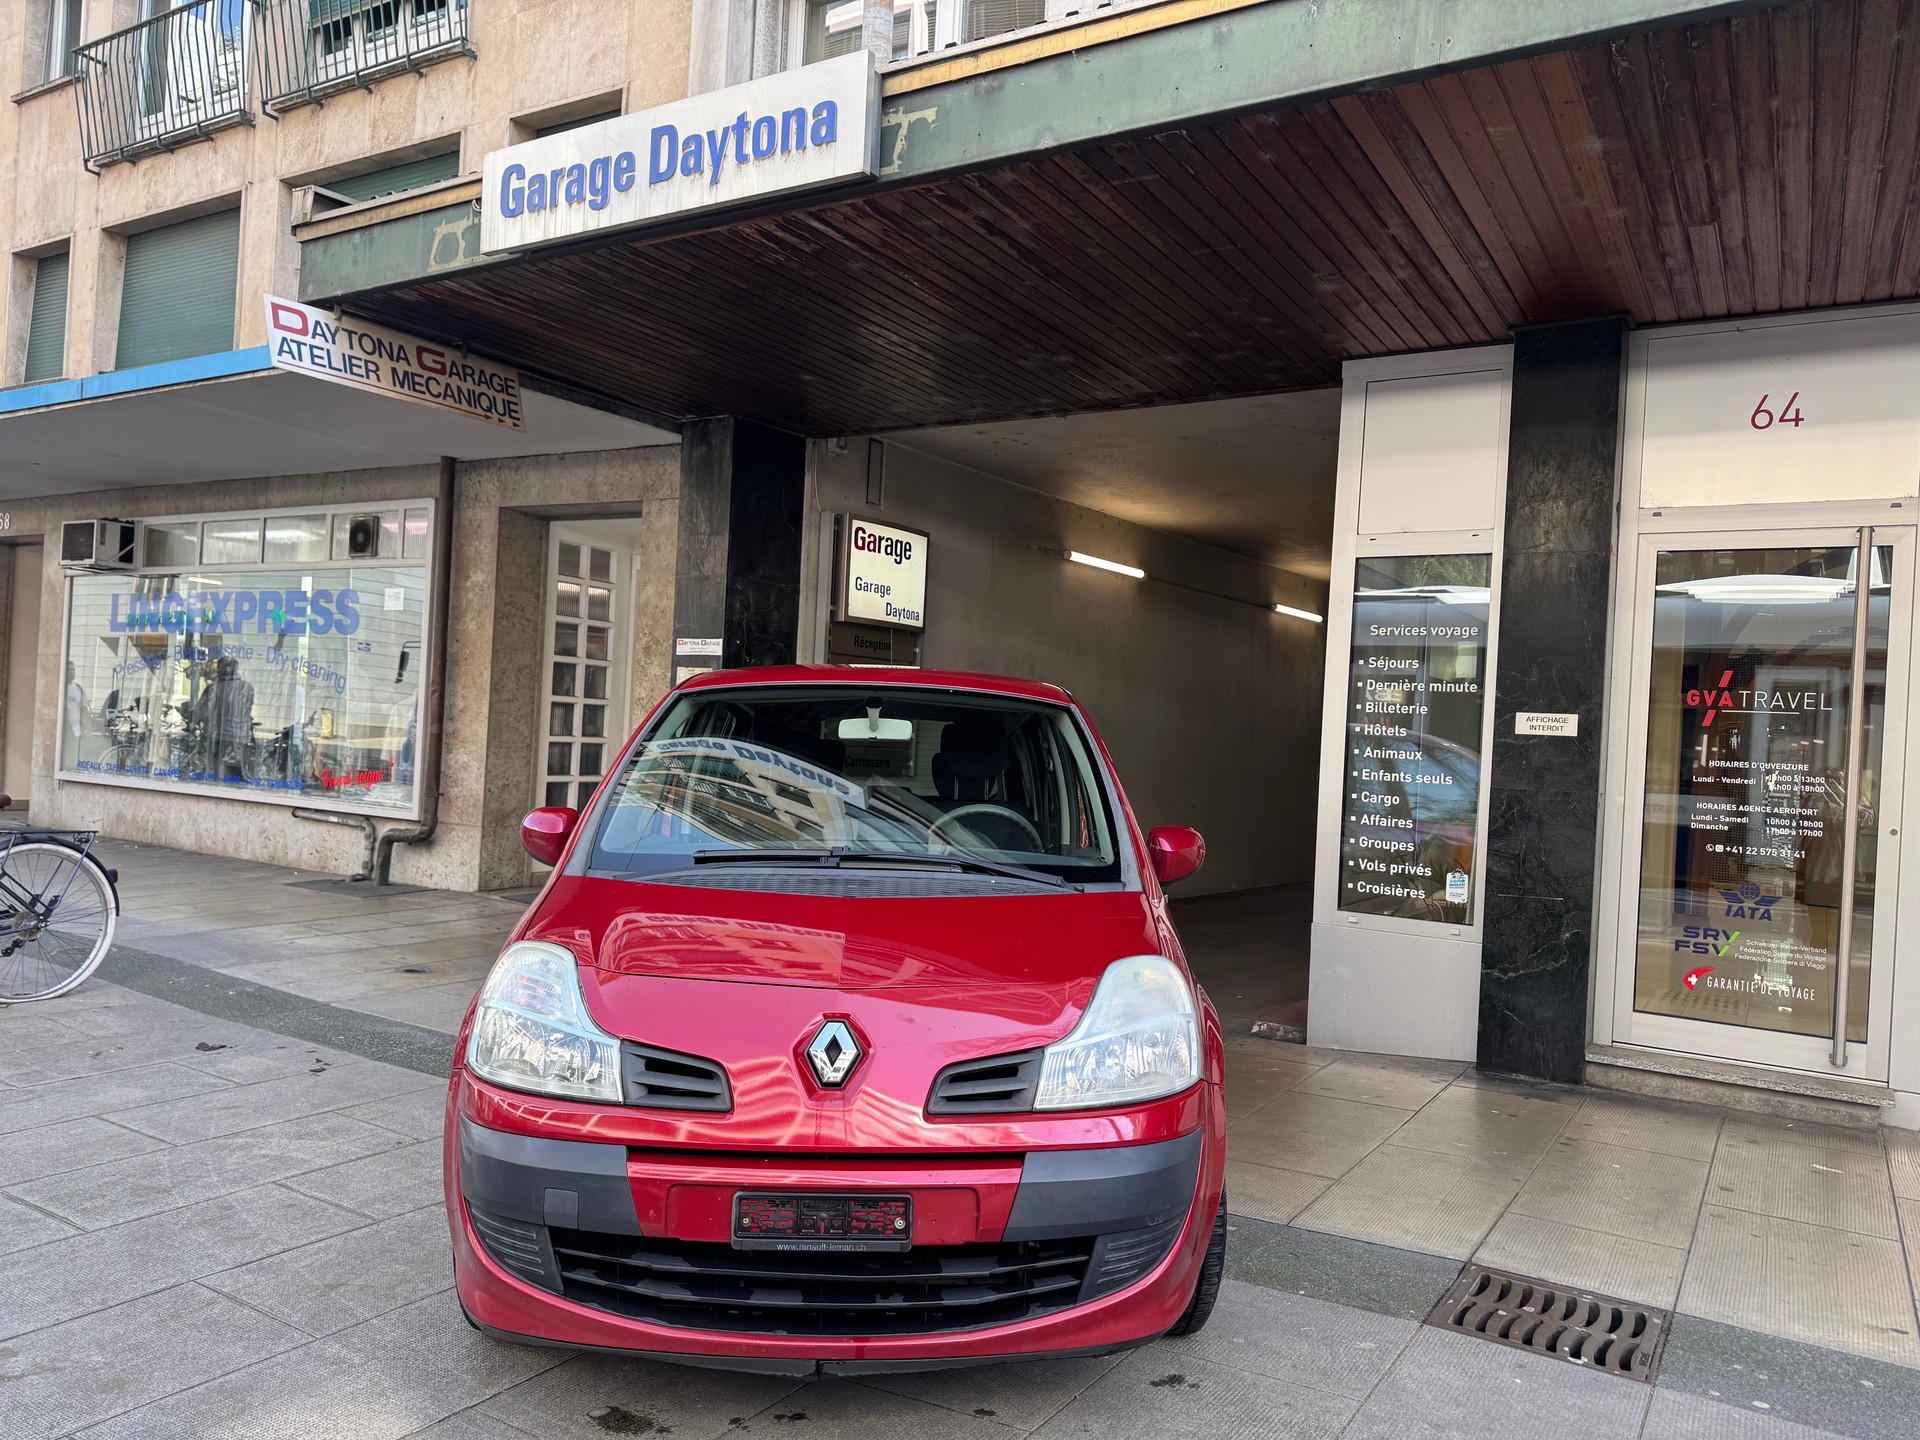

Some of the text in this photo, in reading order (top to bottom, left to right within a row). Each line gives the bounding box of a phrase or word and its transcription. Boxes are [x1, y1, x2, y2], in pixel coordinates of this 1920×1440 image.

[500, 99, 838, 219] Garage Daytona
[270, 301, 518, 398] DAYTONA GARAGE
[277, 336, 521, 421] ATELIER MECANIQUE
[1750, 391, 1805, 430] 64
[854, 526, 912, 565] Garage
[855, 576, 891, 597] Garage
[885, 602, 920, 622] Daytona
[1370, 624, 1479, 638] Services voyage
[266, 646, 289, 671] Dry
[291, 654, 346, 694] cleaning
[1368, 656, 1420, 670] Séjours
[1366, 679, 1478, 693] Dernière minute
[1686, 689, 1833, 710] GVA TRAVEL
[1365, 702, 1428, 714] Billeterie
[1526, 716, 1569, 724] AFFICHAGE
[1364, 724, 1407, 737] Hôtels
[1529, 724, 1565, 732] INTERDIT
[1363, 746, 1423, 760] Animaux
[77, 760, 102, 771] RIDEAUX
[845, 754, 890, 768] Carrosserie
[1709, 760, 1750, 768] HORAIRES
[354, 767, 385, 791] soigné
[1362, 769, 1453, 785] Enfants seuls
[1693, 775, 1714, 783] Lundi
[1721, 776, 1756, 785] Vendredi
[1801, 776, 1826, 784] 13h00
[1800, 785, 1825, 793] 18h00
[1361, 792, 1400, 806] Cargo
[1696, 802, 1818, 816] HORAIRES AGENCE AEROPORT
[1360, 814, 1413, 828] Affaires
[1691, 813, 1713, 821] Lundi
[1720, 815, 1749, 824] Samedi
[1766, 818, 1790, 826] 10h00
[1799, 820, 1823, 828] 18h00
[1691, 822, 1728, 831] Dimanche
[1798, 829, 1823, 837] 17h00
[1359, 836, 1414, 852] Groupes
[1725, 846, 1743, 854] +41
[1746, 847, 1758, 855] 22
[1760, 848, 1777, 857] 575
[1793, 850, 1805, 859] 41
[1358, 858, 1432, 876] Vols privés
[1357, 881, 1426, 898] Croisières
[1725, 905, 1772, 921] IATA
[1683, 925, 1741, 943] SRV
[1674, 940, 1730, 957] FSV
[1804, 953, 1827, 962] Voyage
[1707, 976, 1756, 993] GARANTIE
[776, 1242, 867, 1252] www.renault-leman.ch
